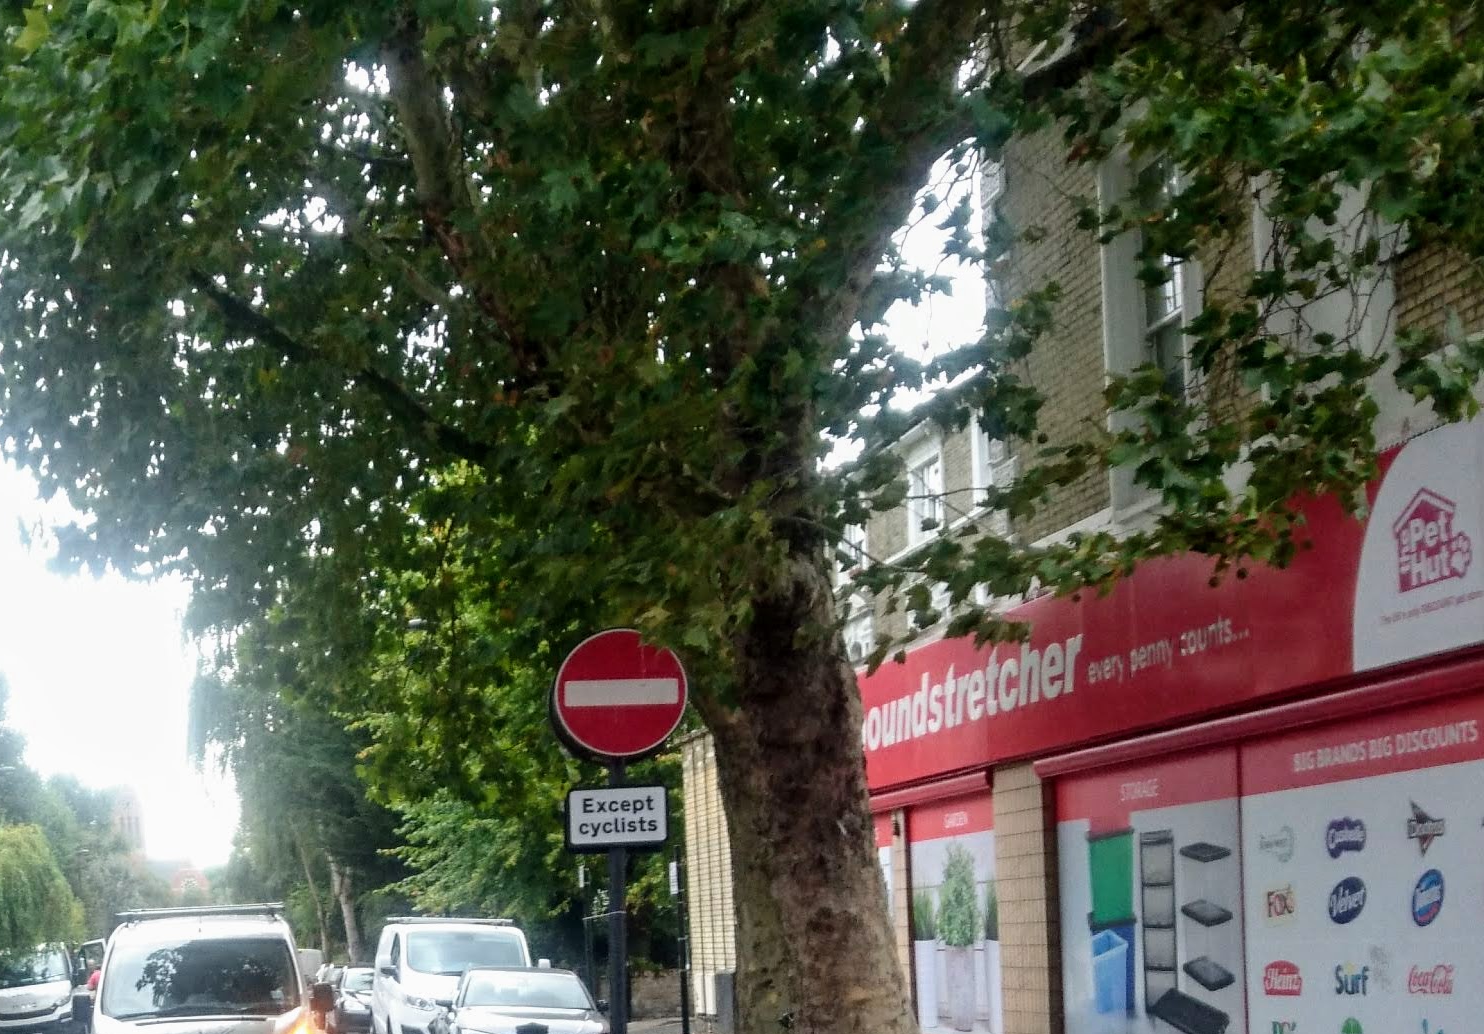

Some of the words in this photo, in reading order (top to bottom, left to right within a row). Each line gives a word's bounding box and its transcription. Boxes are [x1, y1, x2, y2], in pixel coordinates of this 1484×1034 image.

[1409, 511, 1449, 549] Pet
[1410, 547, 1452, 587] Hut
[1087, 654, 1124, 684] every
[1129, 637, 1173, 678] penny
[861, 633, 1083, 751] oundstretcher
[1316, 741, 1366, 768] BRANDS
[1368, 735, 1393, 759] BIG
[1395, 719, 1479, 755] DISCOUNTS
[582, 795, 655, 814] Except
[578, 817, 658, 837] cyclists
[1334, 963, 1369, 996] Surf
